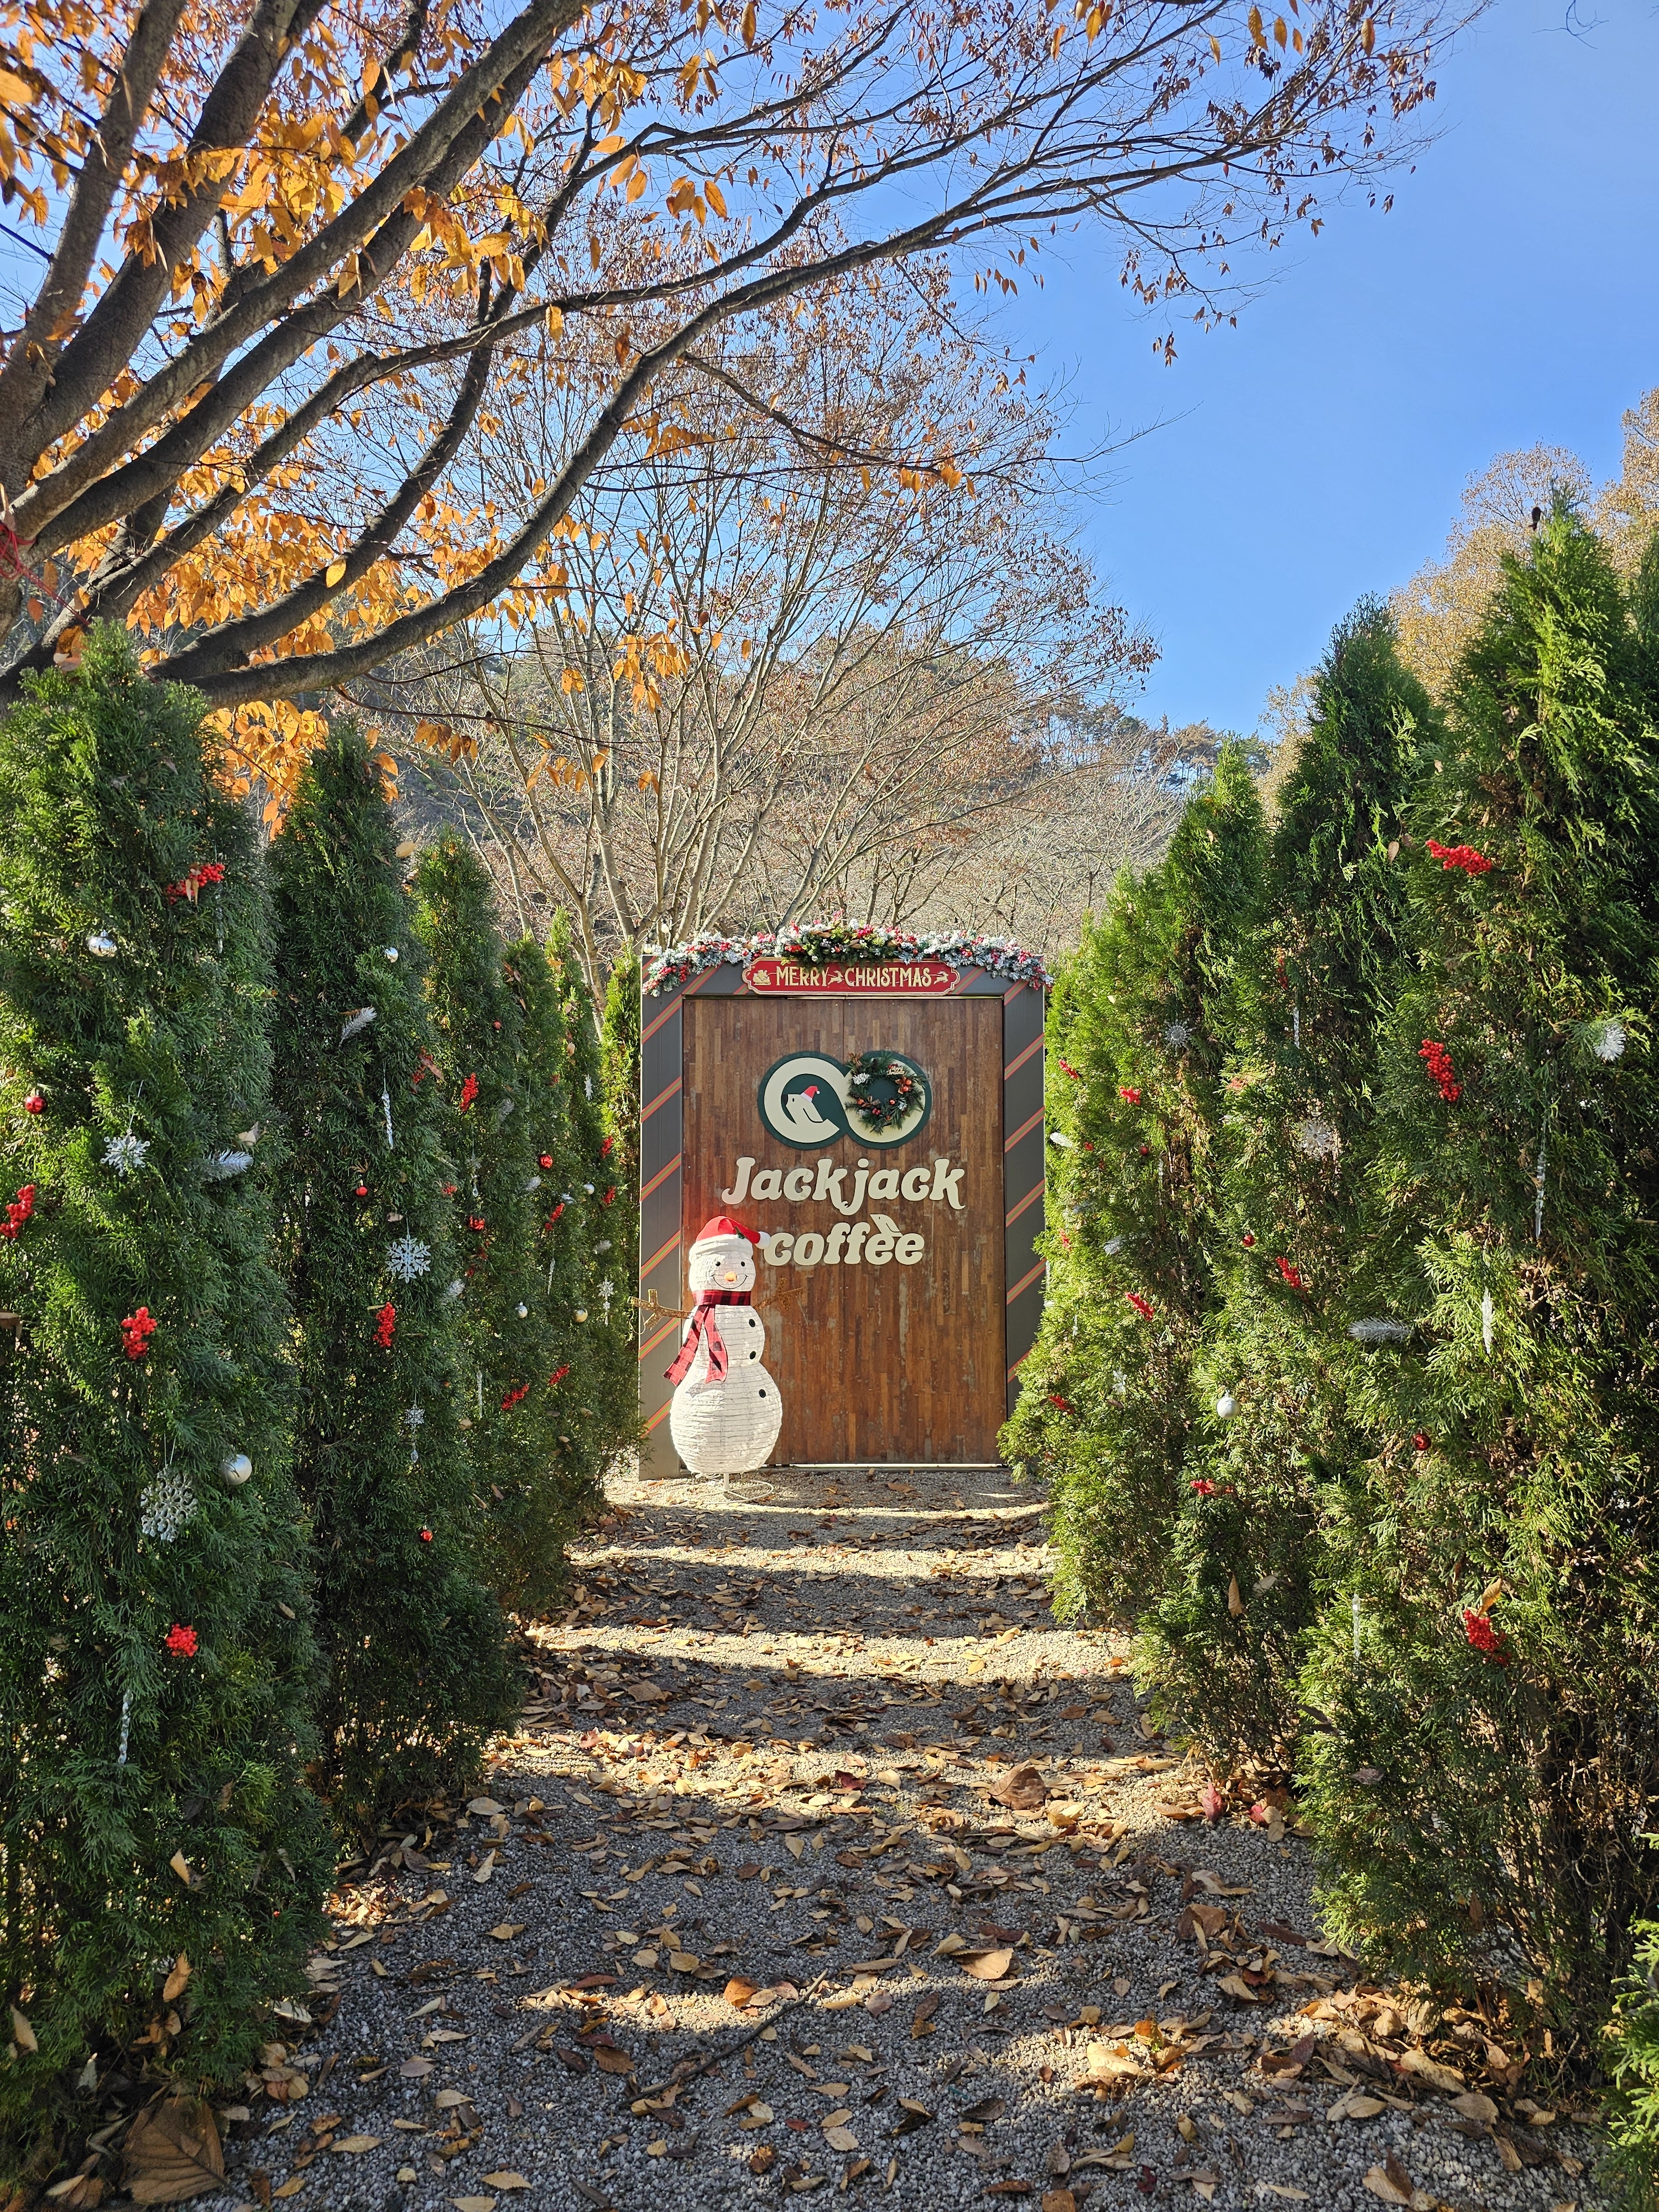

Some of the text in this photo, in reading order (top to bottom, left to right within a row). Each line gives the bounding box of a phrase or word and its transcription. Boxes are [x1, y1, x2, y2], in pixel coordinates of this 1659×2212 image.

[776, 966, 932, 987] MERRY CHRISTMAS
[721, 1157, 966, 1215] Jackjack
